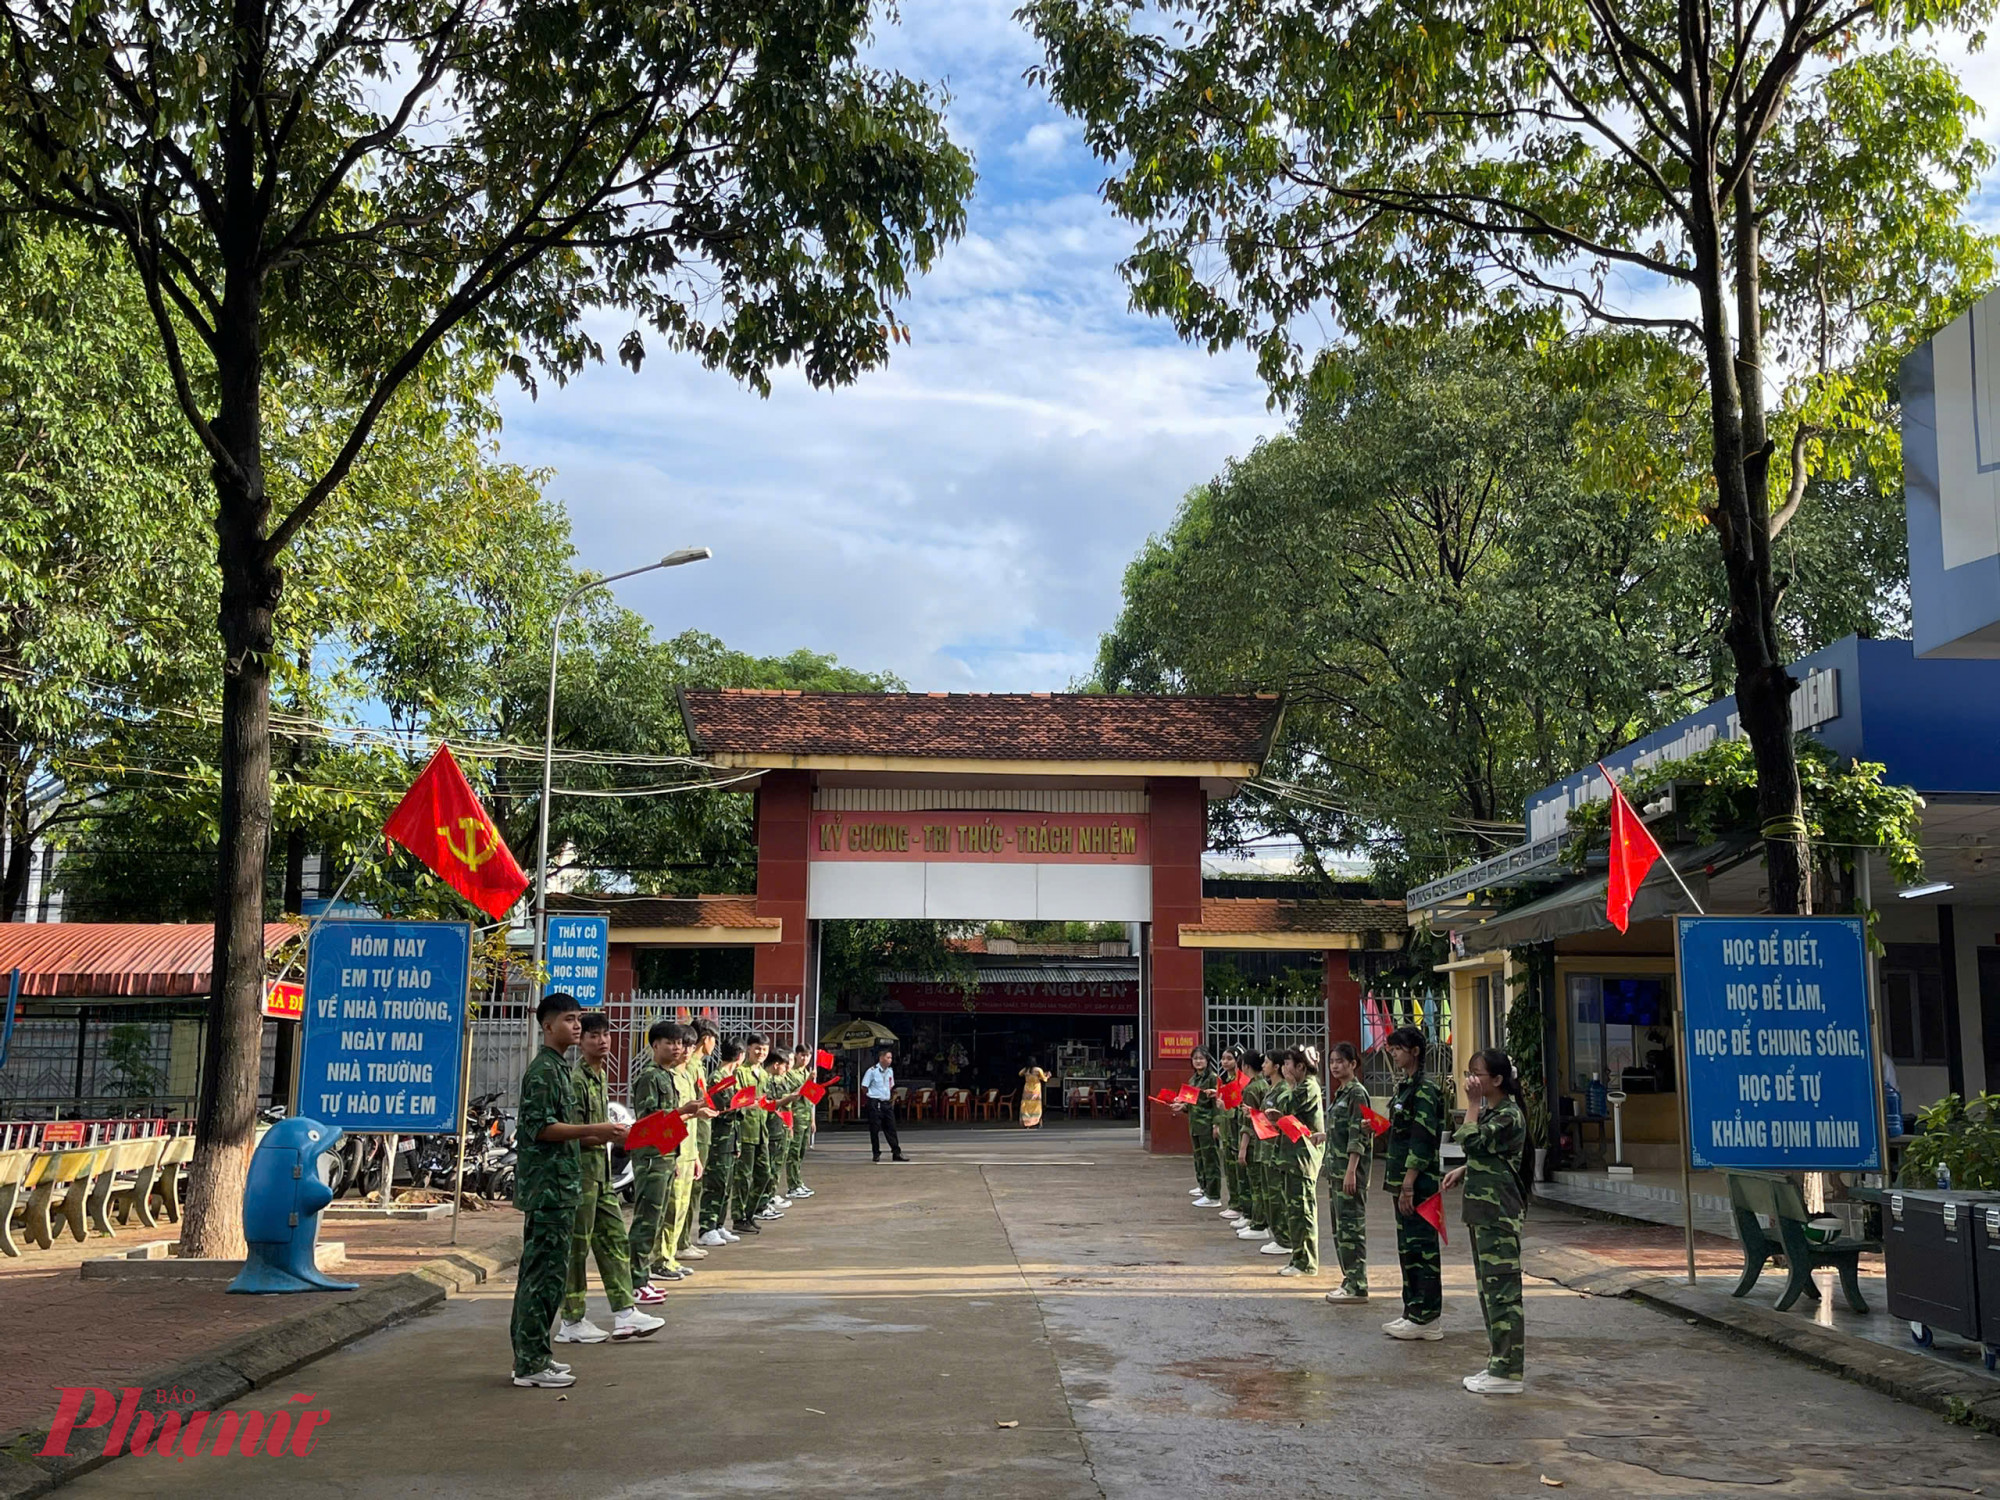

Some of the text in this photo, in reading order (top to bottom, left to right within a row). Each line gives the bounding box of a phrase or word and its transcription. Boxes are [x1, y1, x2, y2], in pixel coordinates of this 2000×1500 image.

[1790, 667, 1838, 732] HIỆM
[820, 815, 843, 851] KỶ
[850, 821, 909, 851] CƯƠNG
[924, 824, 950, 852] TRI
[958, 817, 1003, 853] THỨC
[1017, 820, 1072, 853] TRÁCH
[1078, 821, 1136, 860] NHIỆM
[350, 934, 426, 957] HÔM NAY
[584, 924, 597, 939] CÔ
[552, 941, 600, 961] MẪU MỰC,
[1723, 929, 1823, 971] HỌC ĐỂ BIẾT,
[341, 965, 431, 992] EM TỰ HÀO
[553, 965, 598, 980] HỌC SINH
[553, 983, 596, 1000] TÍCH CỰC
[1726, 974, 1826, 1016] HỌC ĐỂ LÀM,
[317, 993, 452, 1022] VỀ NHÀ TRƯỜNG,
[341, 1027, 423, 1051] NGÀY MAI
[1695, 1019, 1865, 1061] HỌC ĐỂ CHUNG SỐNG,
[327, 1059, 432, 1083] NHÀ TRƯỜNG
[1739, 1064, 1822, 1107] HỌC ĐỂ TỰ
[321, 1089, 436, 1117] TỰ HÀO VỀ EM
[1711, 1109, 1860, 1154] KHẲNG ĐỊNH MÌNH
